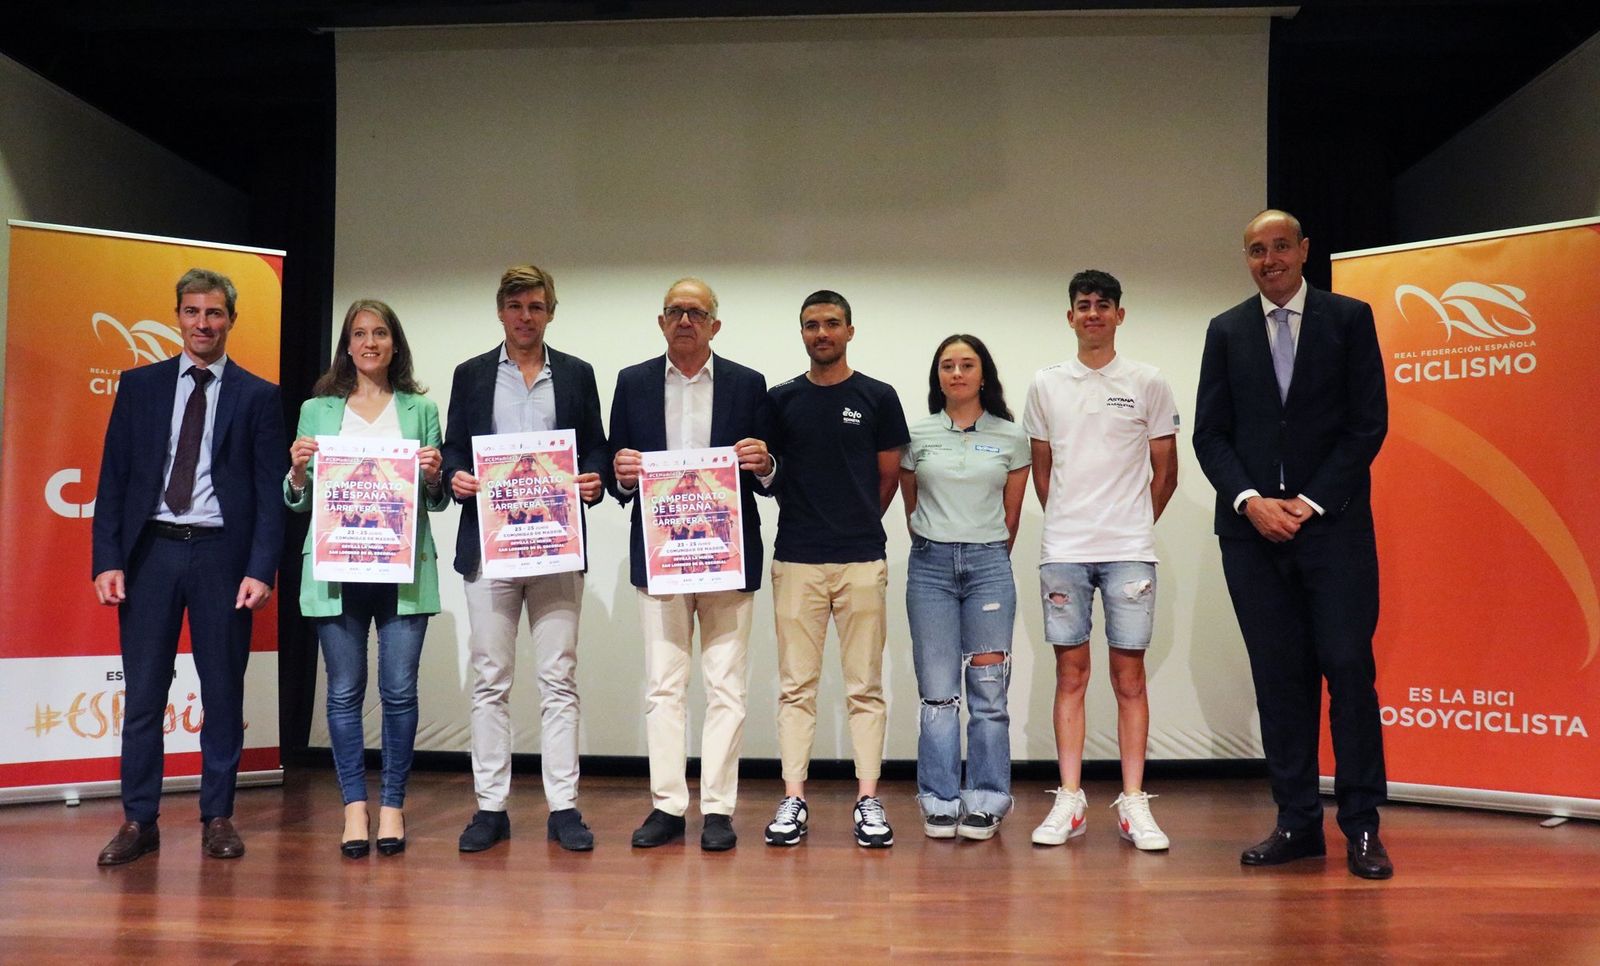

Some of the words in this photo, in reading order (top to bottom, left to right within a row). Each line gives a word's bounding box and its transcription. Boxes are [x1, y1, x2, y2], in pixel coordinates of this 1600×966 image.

[1394, 351, 1418, 359] REAL
[1421, 345, 1481, 357] FEDERACIÓN
[1485, 340, 1536, 351] ESPAÑOLA
[1394, 352, 1537, 384] CICLISMO
[325, 480, 402, 490] CAMPEONATO
[487, 475, 564, 488] CAMPEONATO
[325, 490, 340, 499] DE
[342, 488, 387, 500] ESPAÑA
[488, 490, 502, 498] DE
[506, 485, 550, 497] ESPAÑA
[652, 491, 726, 504] CAMPEONATO
[324, 504, 377, 512] CARRETERA
[489, 502, 541, 510] CARRETERA
[652, 506, 665, 514] DE
[669, 501, 712, 512] ESPAÑA
[652, 517, 704, 526] CARRETERA
[1408, 688, 1432, 702] ES
[1440, 688, 1466, 704] LA
[1472, 690, 1515, 706] BICI
[1380, 706, 1589, 738] OSOYCICLISTA
